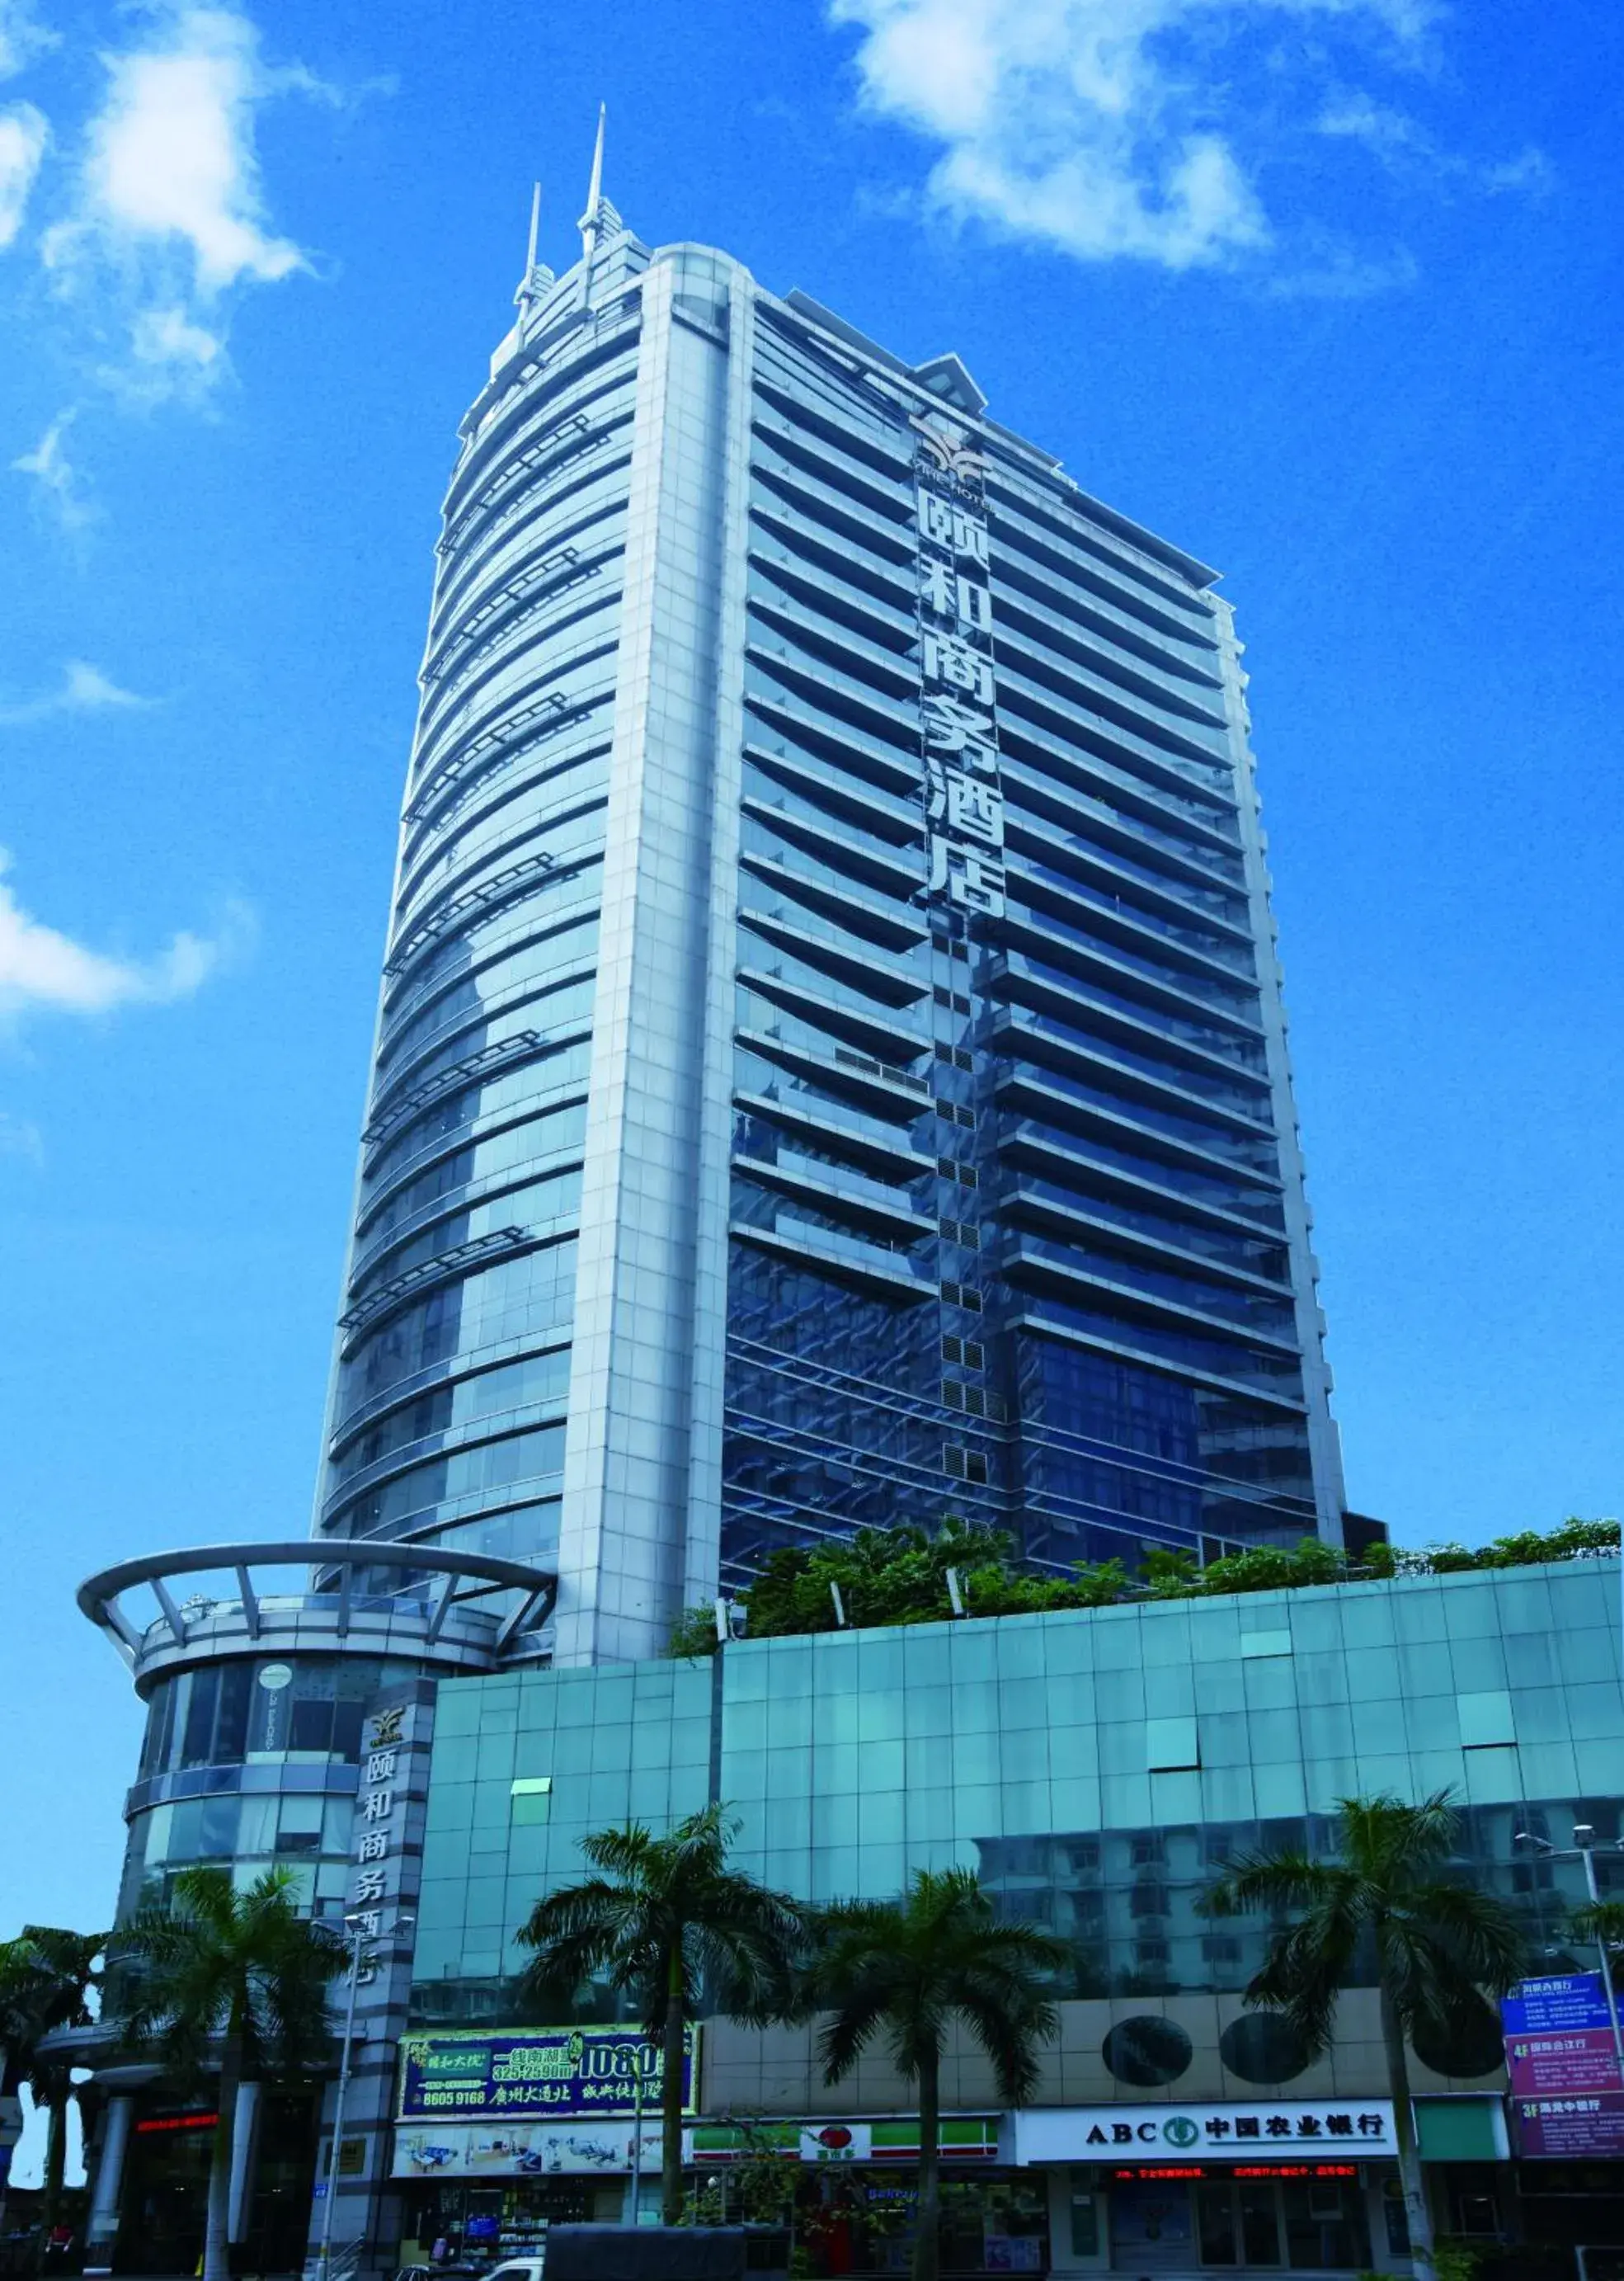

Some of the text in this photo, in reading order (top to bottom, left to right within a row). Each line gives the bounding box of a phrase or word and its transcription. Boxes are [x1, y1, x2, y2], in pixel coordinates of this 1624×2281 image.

[916, 485, 1004, 918] 颐和商务酒店
[1086, 2122, 1157, 2144] ABC
[1205, 2113, 1384, 2138] 中国农业银行
